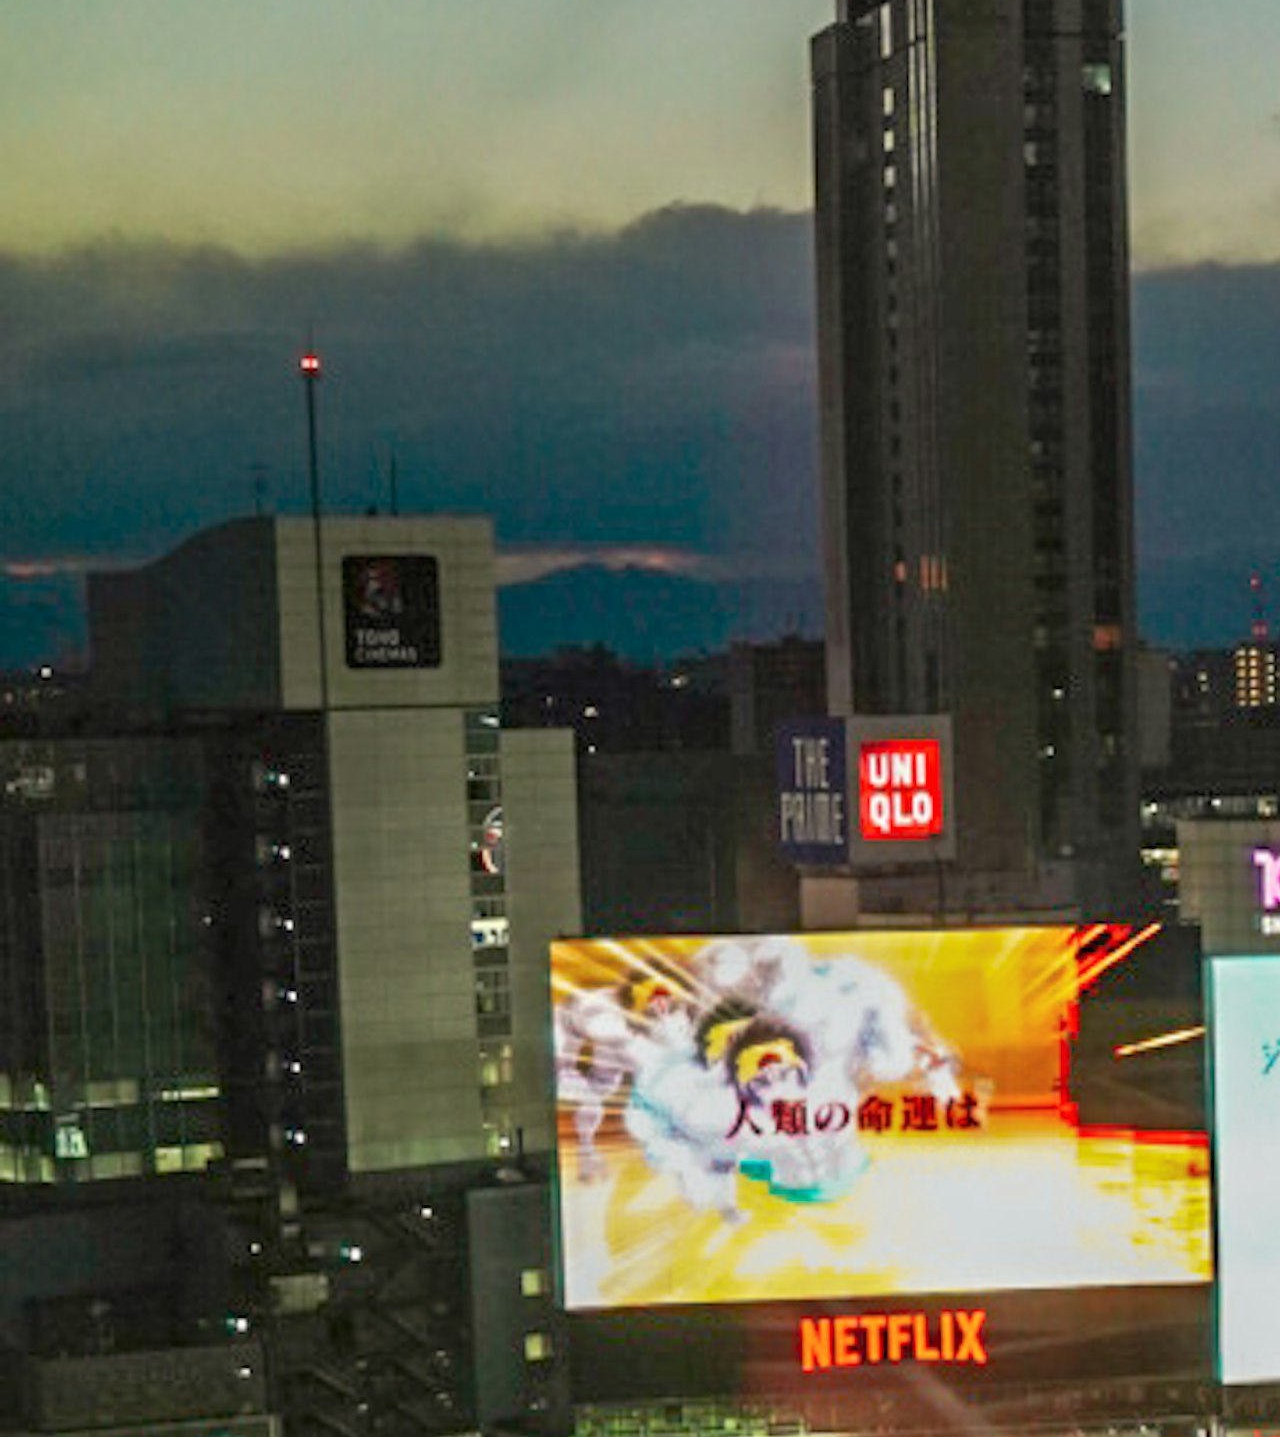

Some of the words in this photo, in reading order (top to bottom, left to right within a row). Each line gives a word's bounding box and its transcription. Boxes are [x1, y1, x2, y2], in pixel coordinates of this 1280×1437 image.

[792, 737, 829, 788] THE
[868, 752, 927, 787] UNI
[869, 791, 934, 833] QLO
[726, 1094, 984, 1138] 人類の命運は
[800, 1310, 988, 1371] NETFLIX
